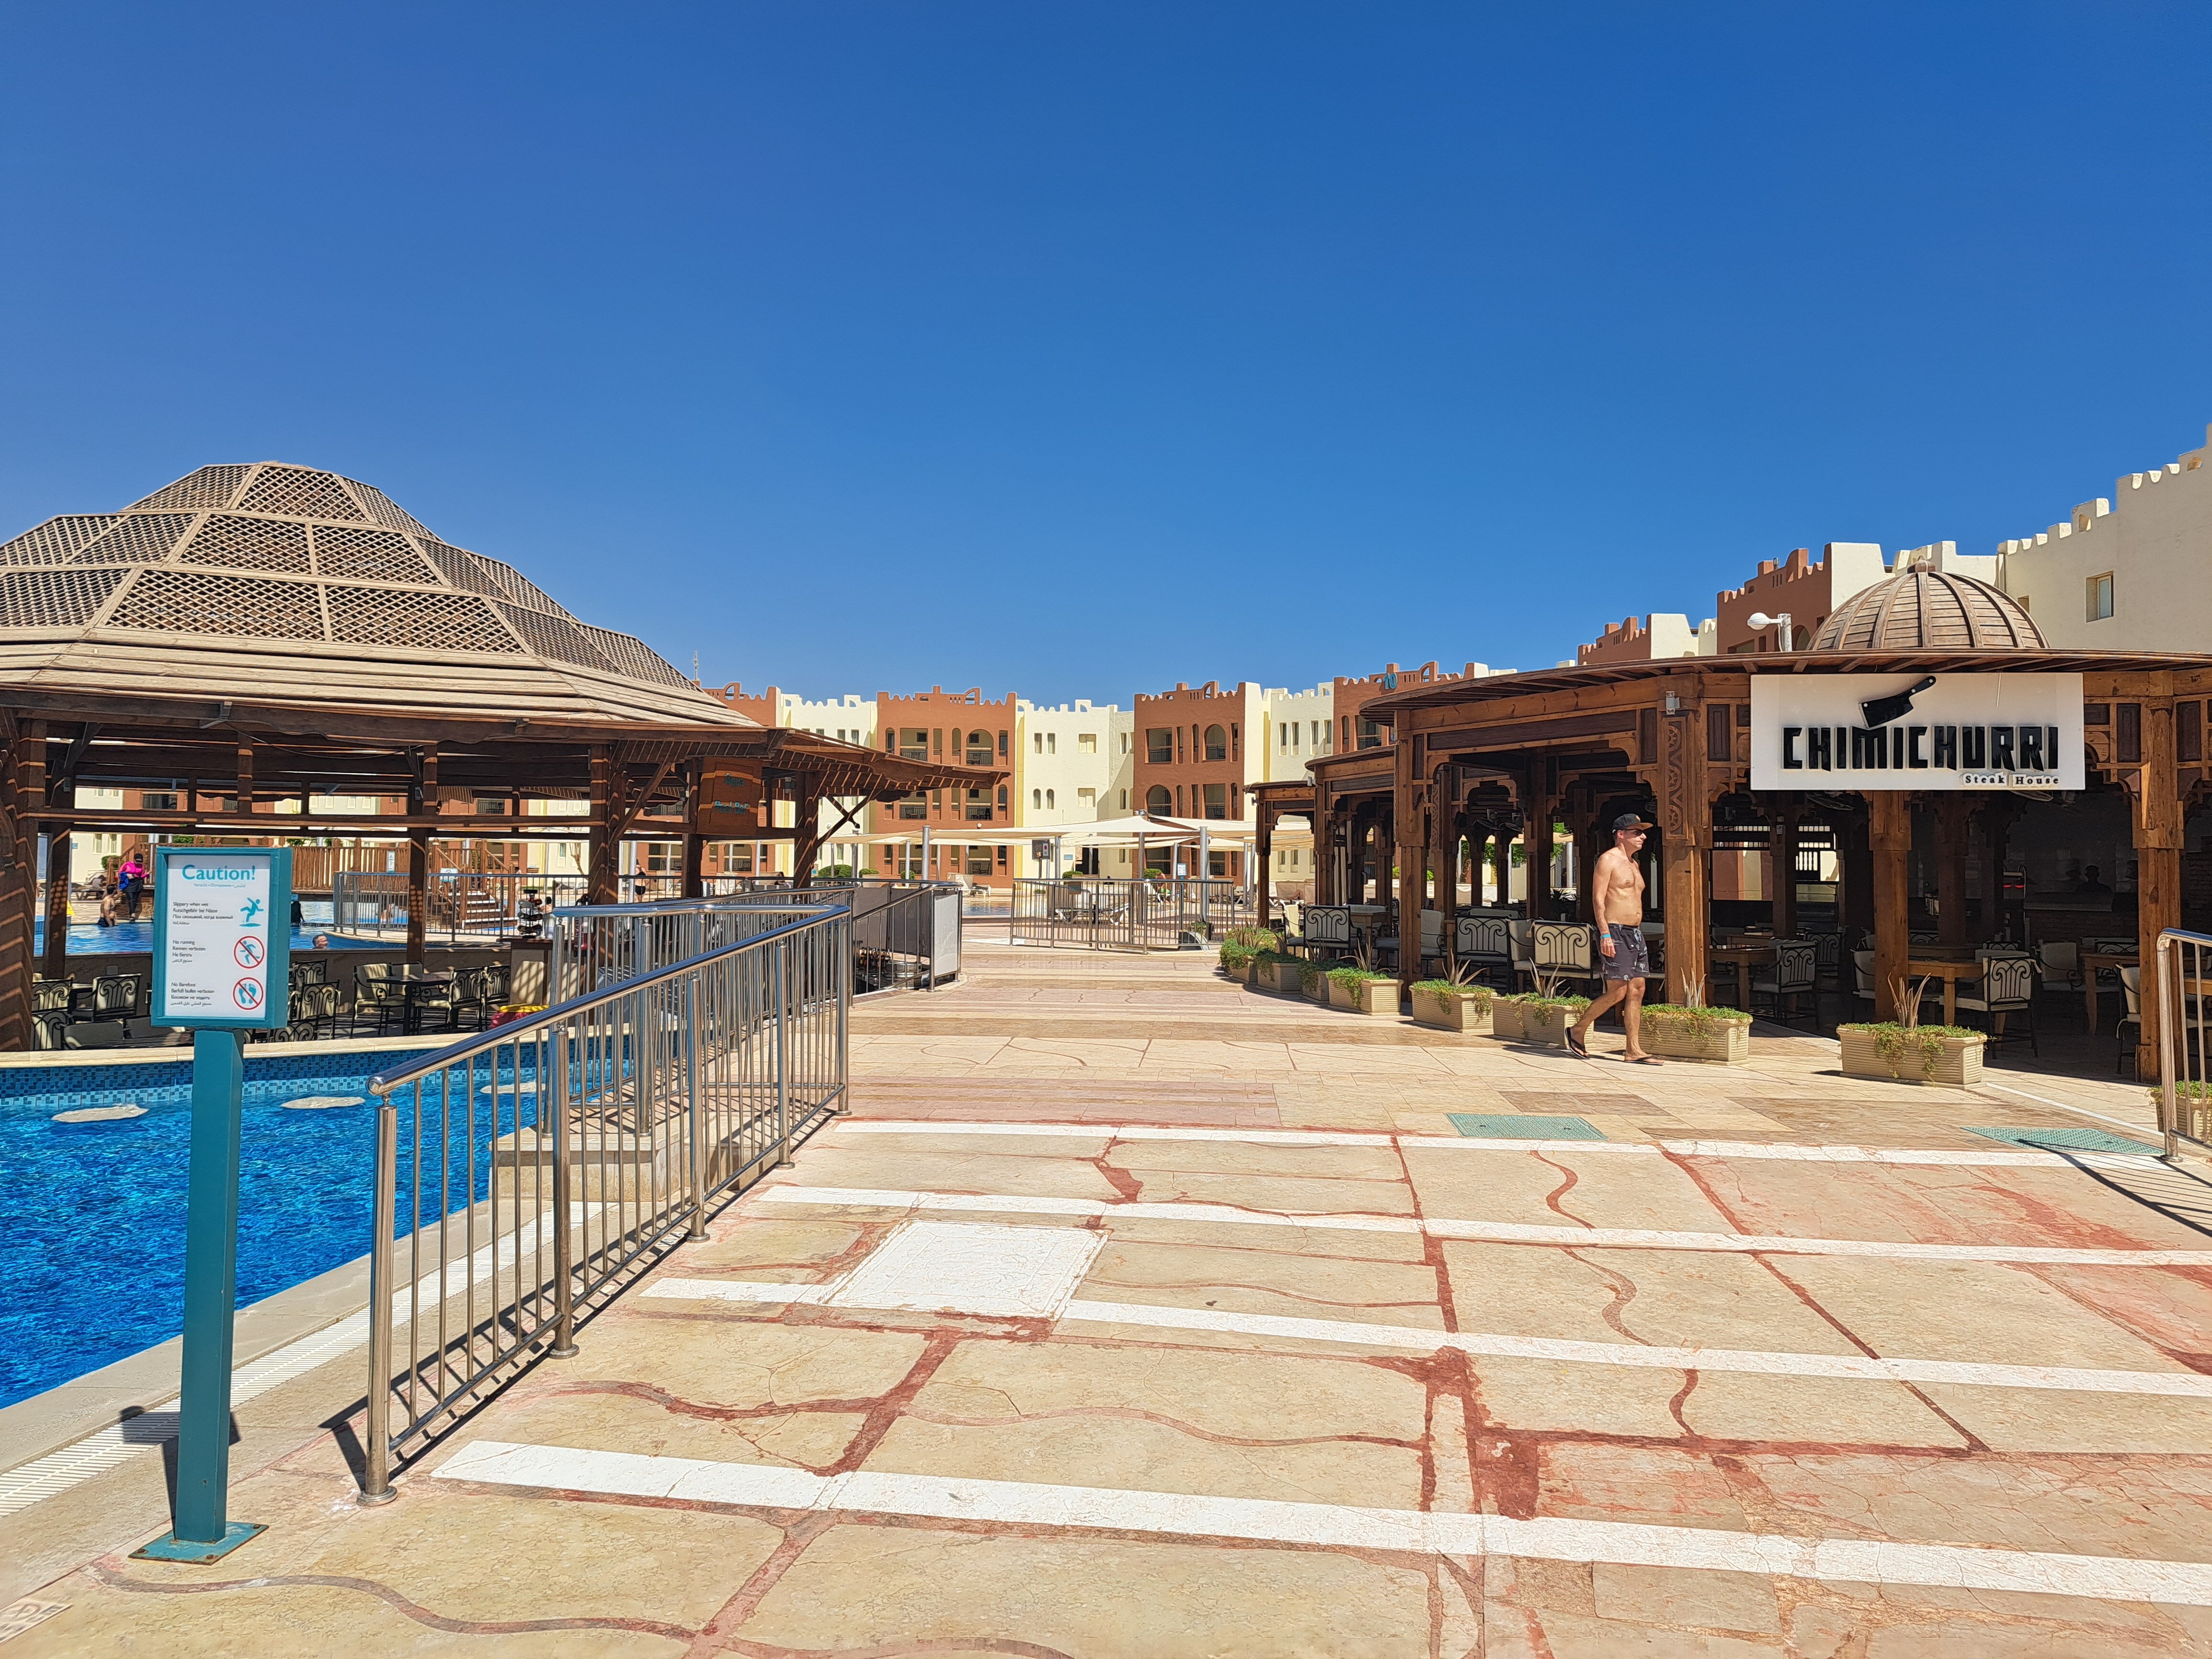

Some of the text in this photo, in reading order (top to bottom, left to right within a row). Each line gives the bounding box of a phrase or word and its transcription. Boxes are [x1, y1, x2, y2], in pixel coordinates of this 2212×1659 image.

[1781, 726, 2058, 772] CHIMICHURRI
[723, 773, 744, 788] Aqua
[1965, 775, 2058, 785] Steak House
[714, 800, 749, 814] Pool Bar
[182, 864, 255, 880] Caution!
